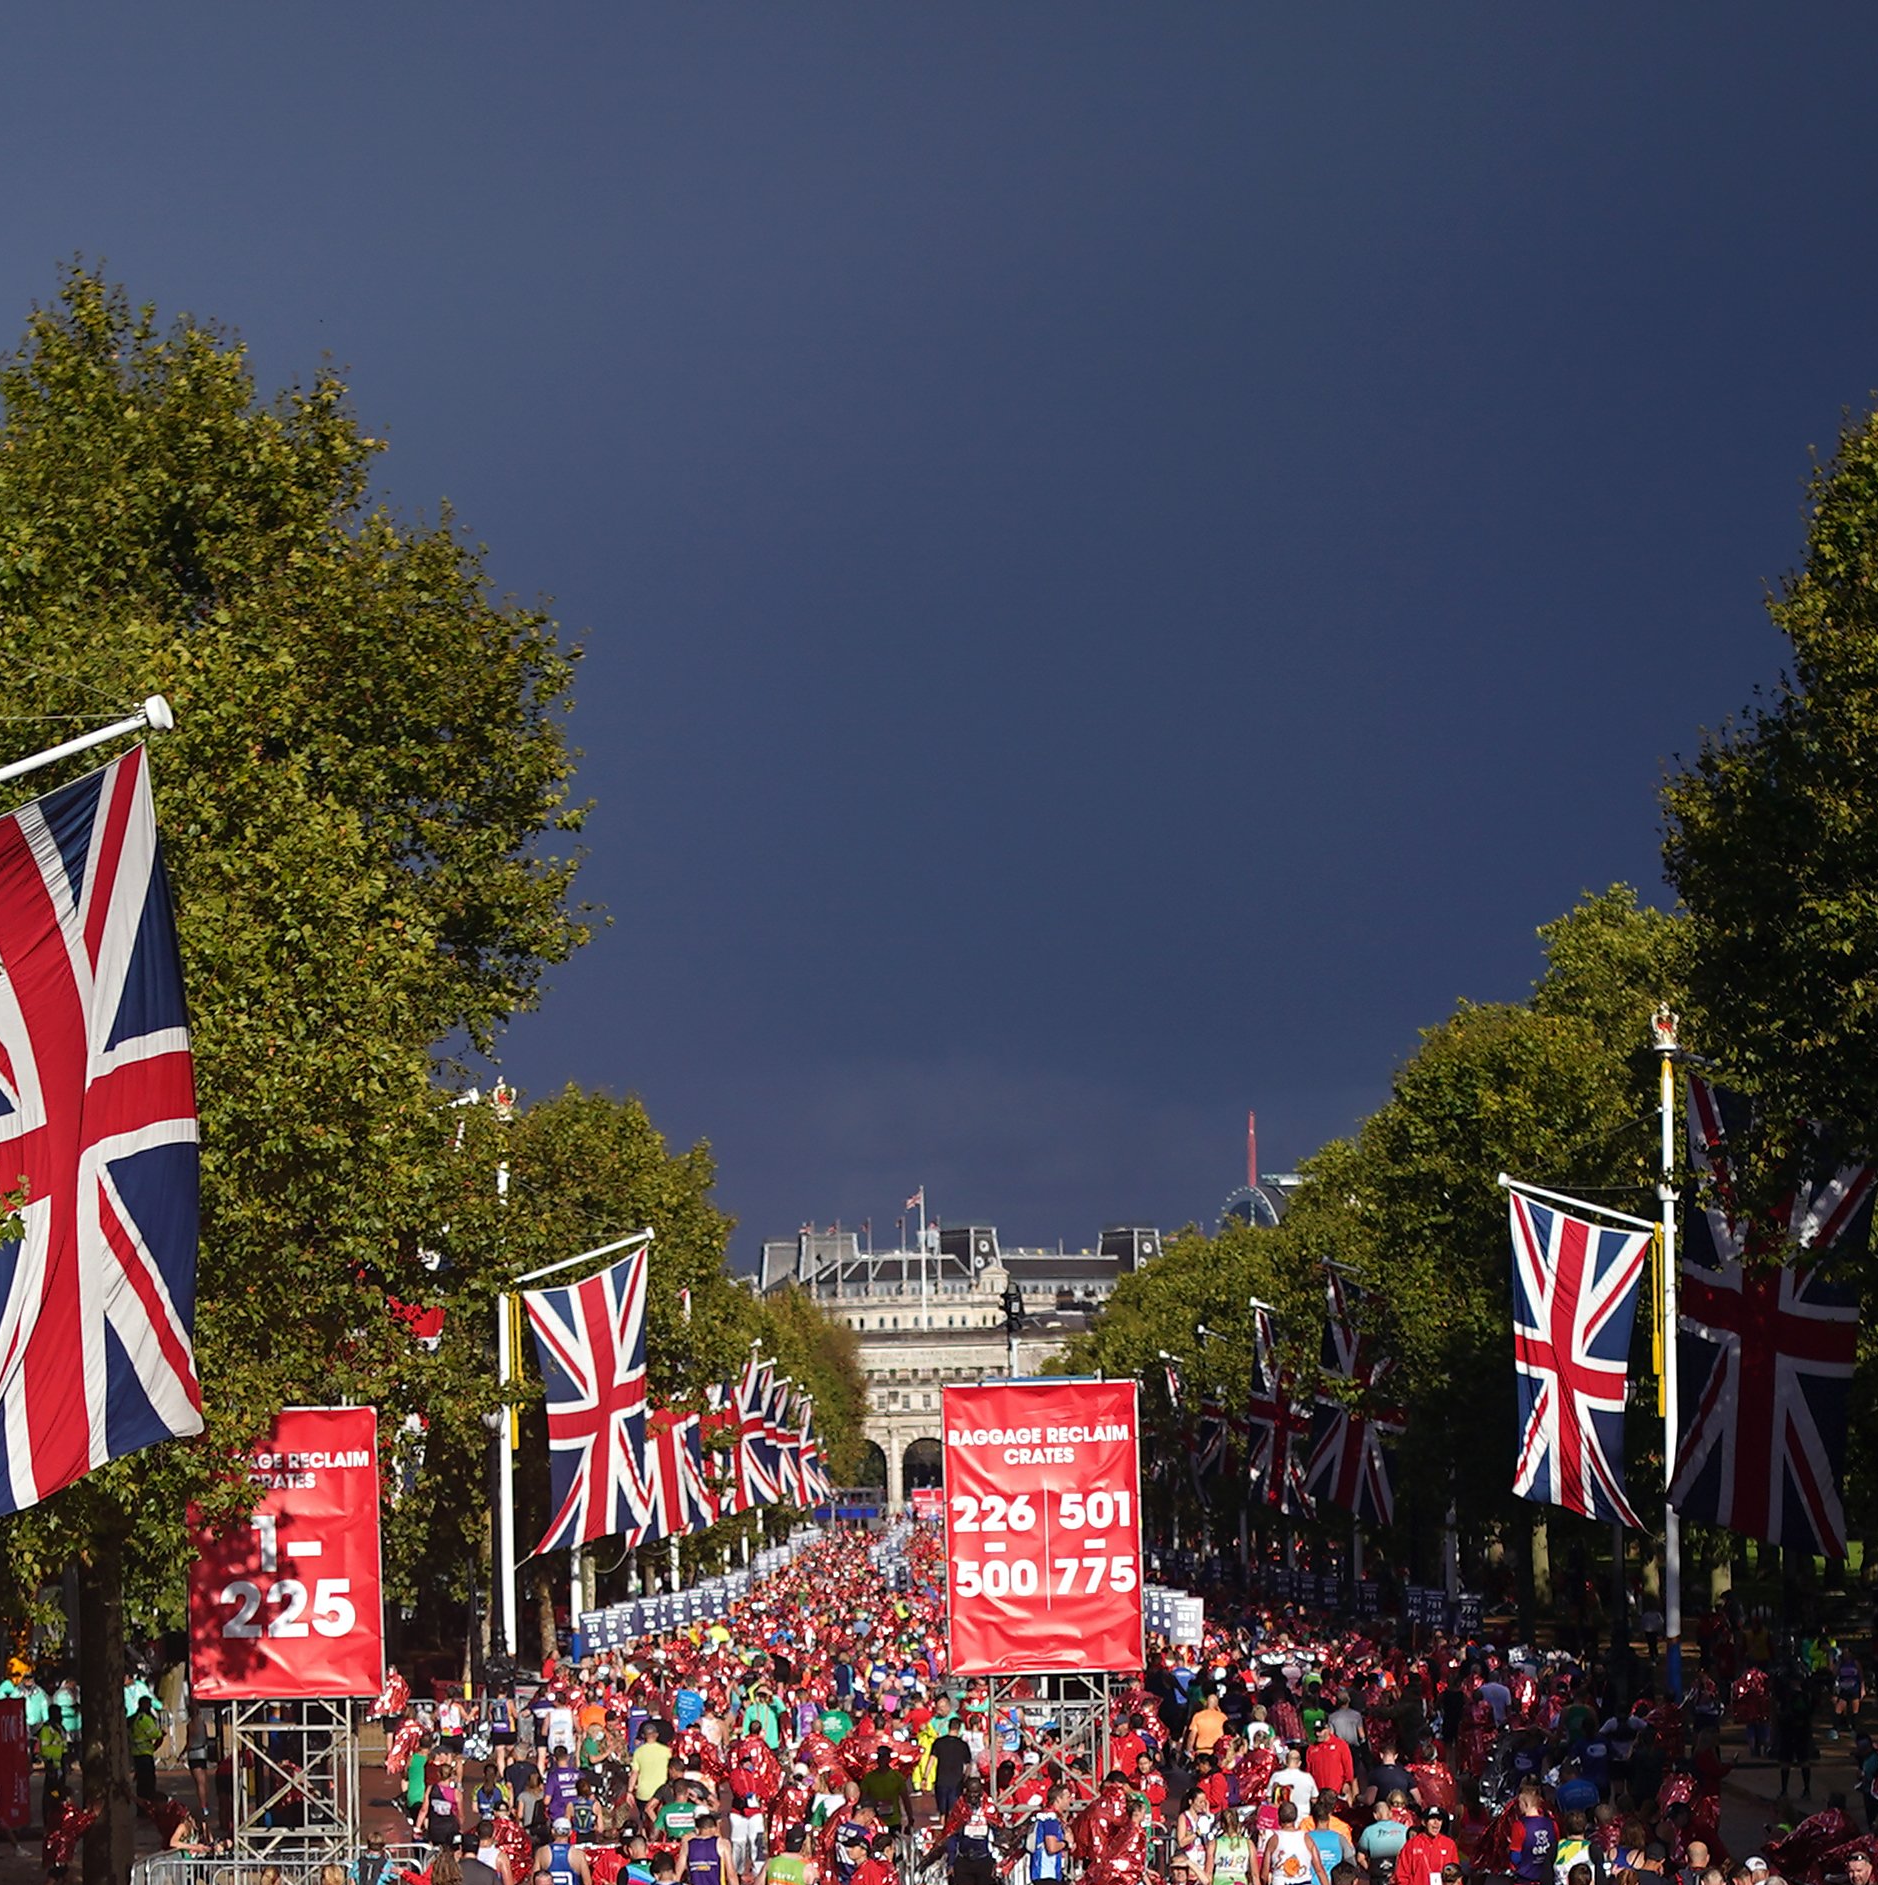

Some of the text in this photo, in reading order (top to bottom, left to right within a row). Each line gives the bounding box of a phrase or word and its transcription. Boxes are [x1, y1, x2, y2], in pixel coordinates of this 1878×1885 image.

[948, 1424, 1129, 1446] BAGGAGE RECLAIM
[288, 1451, 370, 1469] RECLAIM
[1004, 1447, 1076, 1464] CRATES
[952, 1494, 1037, 1533] 226
[1057, 1491, 1131, 1530] 501
[955, 1559, 1039, 1598] 500
[1054, 1556, 1138, 1595] 775
[221, 1578, 357, 1639] 225
